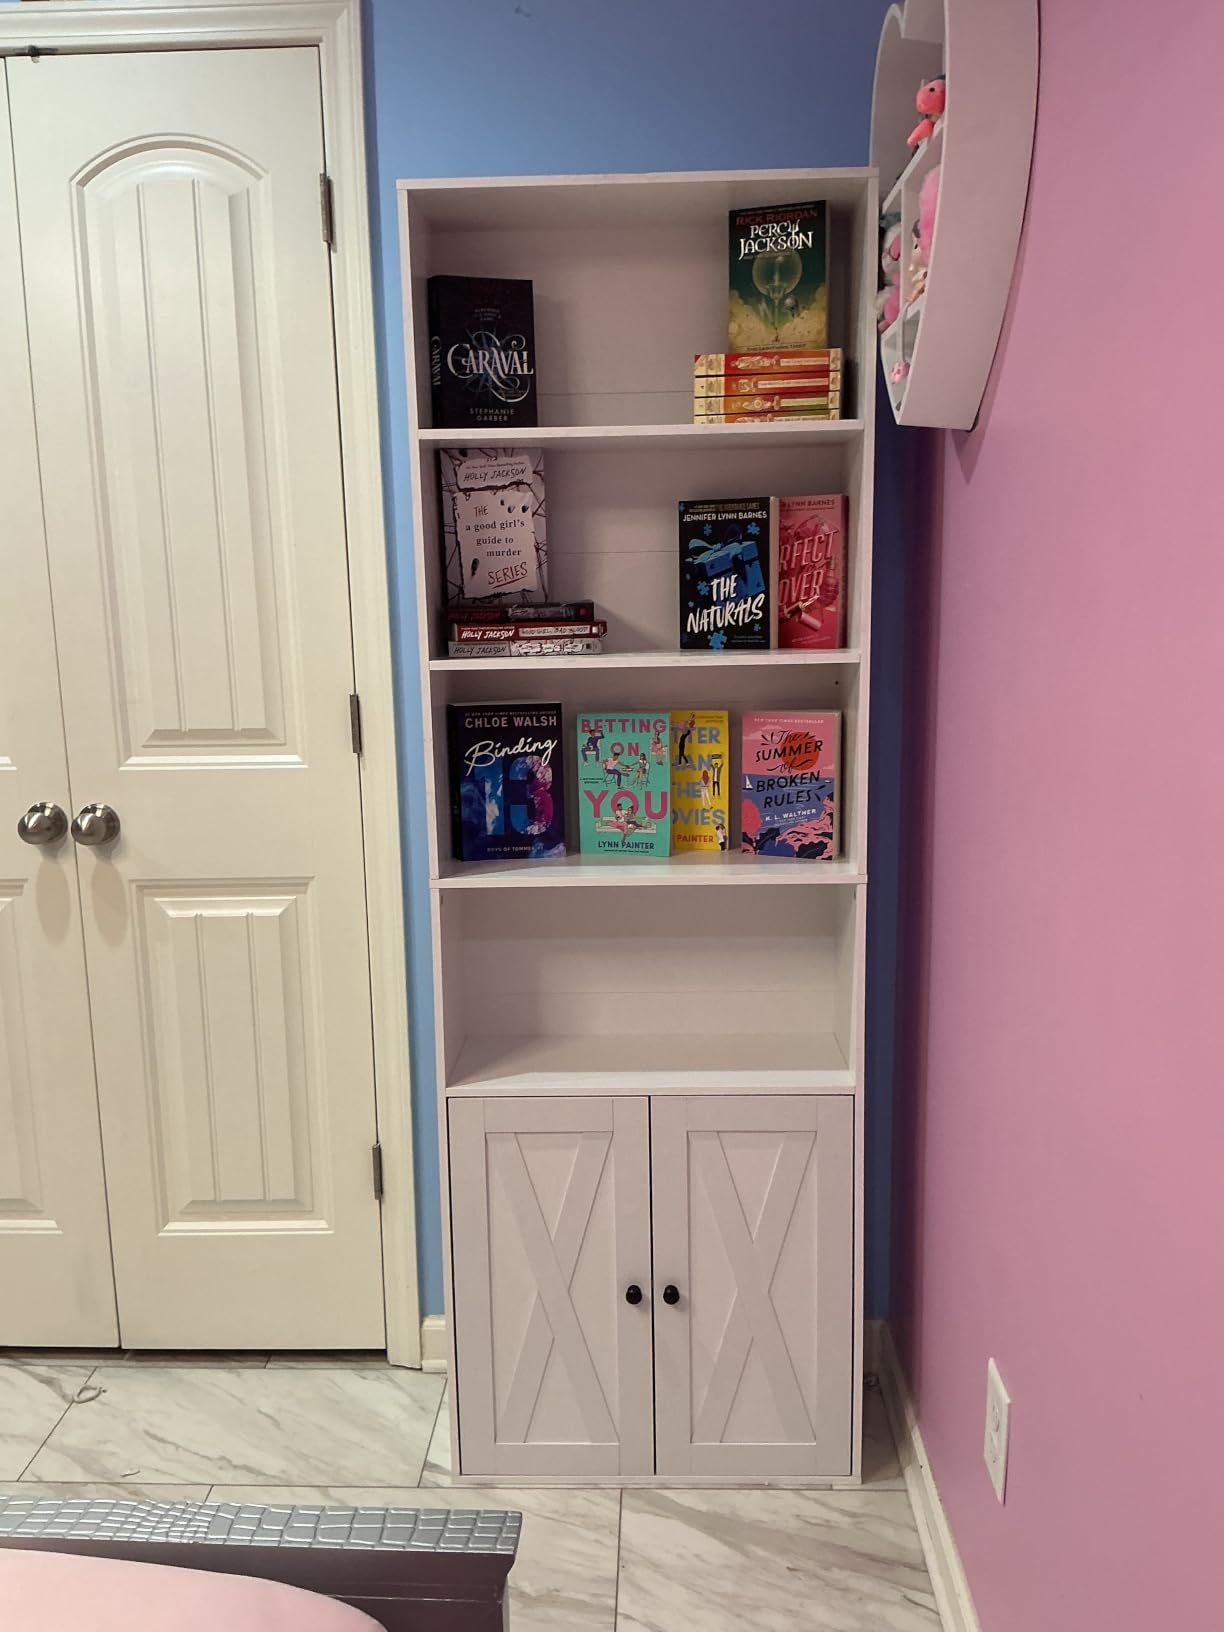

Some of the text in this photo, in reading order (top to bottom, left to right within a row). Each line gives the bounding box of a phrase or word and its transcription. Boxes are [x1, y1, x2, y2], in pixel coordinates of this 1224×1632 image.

[736, 216, 762, 225] RICK
[766, 208, 817, 221] RIORDAN
[750, 219, 800, 239] PERCY
[738, 231, 814, 260] JACKSON
[463, 466, 527, 482] HOLLY JACKSON
[473, 505, 489, 518] THE
[683, 511, 767, 522] JENNIFER LYNN BARNES
[474, 521, 496, 532] good
[500, 519, 525, 531] girl's
[476, 536, 502, 546] guide
[486, 549, 522, 557] murder
[779, 530, 838, 571] RFECT
[488, 562, 528, 585] SERIES
[710, 574, 738, 601] THE
[779, 570, 824, 605] OVER
[686, 593, 766, 634] NATURALS
[461, 629, 515, 640] HOLLY JACKSON
[454, 645, 507, 655] HOLLY JACKSON
[465, 715, 557, 729] CHLOE WALSH
[581, 718, 667, 734] BETTING
[464, 737, 558, 776] Binding
[610, 742, 640, 757] ON
[756, 740, 824, 762] SUMMER
[671, 781, 702, 798] HE
[756, 770, 820, 793] BROKEN
[474, 755, 554, 836] 13
[764, 790, 812, 809] RULES
[584, 790, 668, 820] YOU
[782, 808, 817, 819] WALTHER
[671, 808, 725, 825] VIES
[598, 840, 655, 850] LYNN PAINTER
[676, 834, 714, 843] PAINTER
